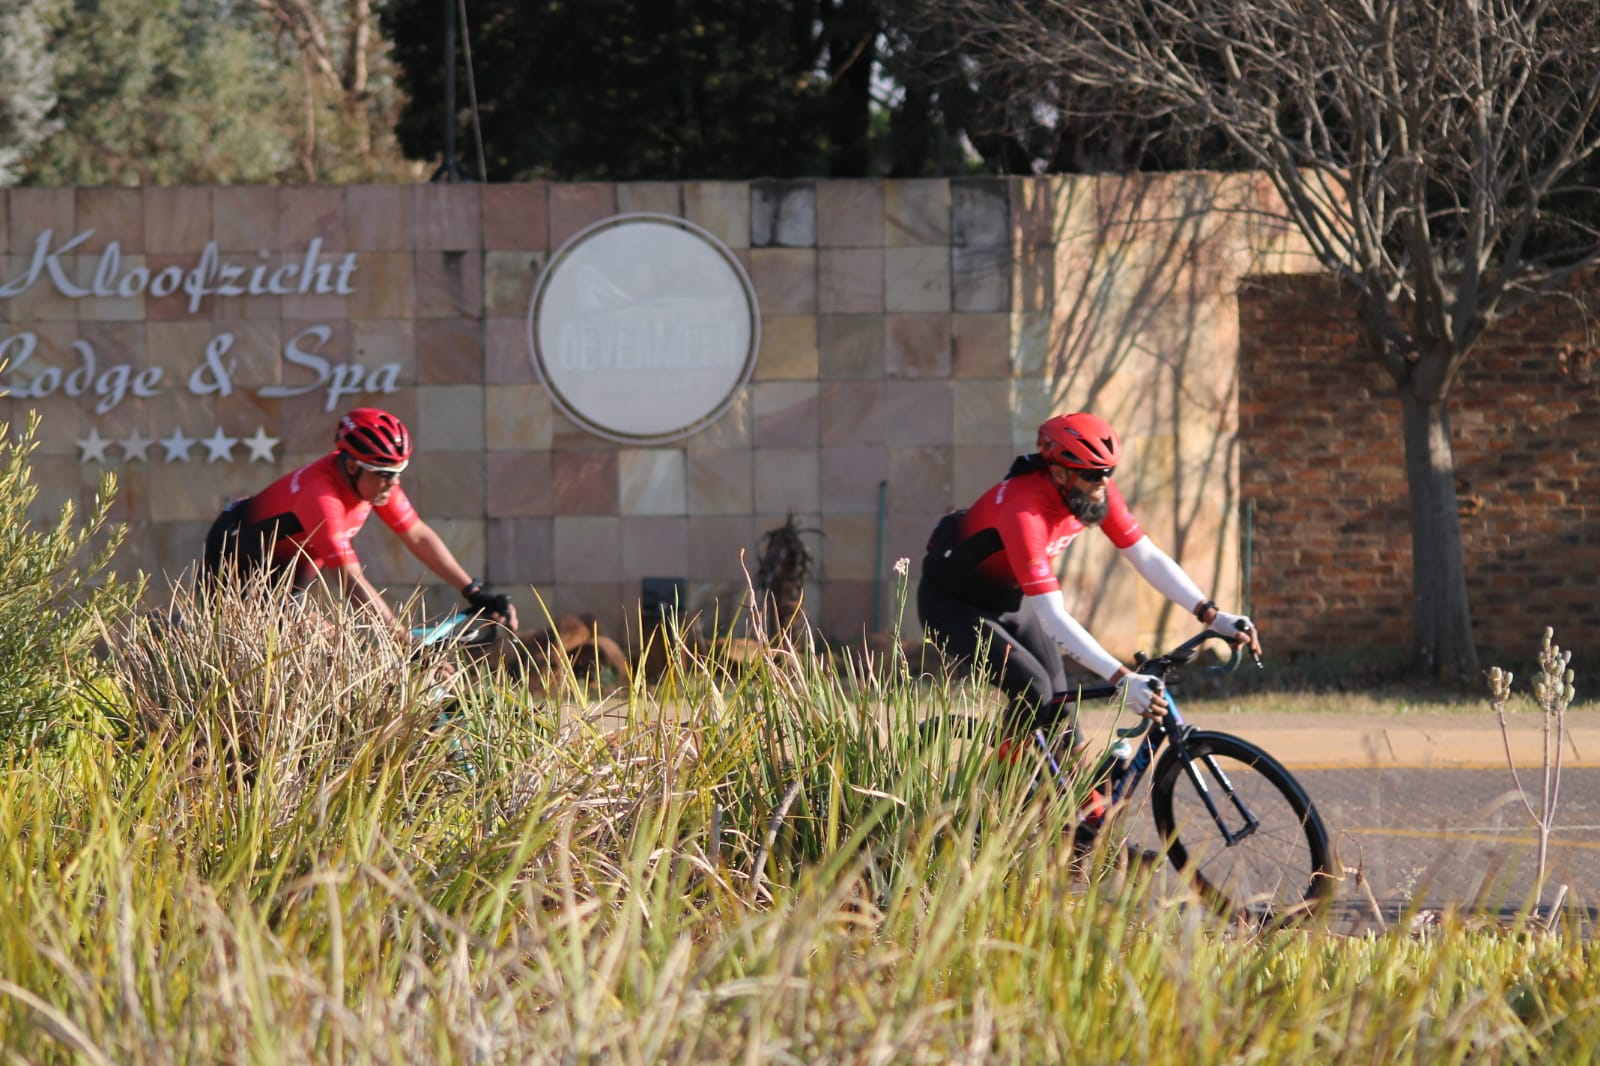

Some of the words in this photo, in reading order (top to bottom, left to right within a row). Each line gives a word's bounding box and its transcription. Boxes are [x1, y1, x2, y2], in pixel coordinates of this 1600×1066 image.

[0, 227, 358, 313] Kloofzicht
[0, 332, 164, 414] Lodge
[188, 332, 238, 397] &
[257, 325, 402, 413] Spa
